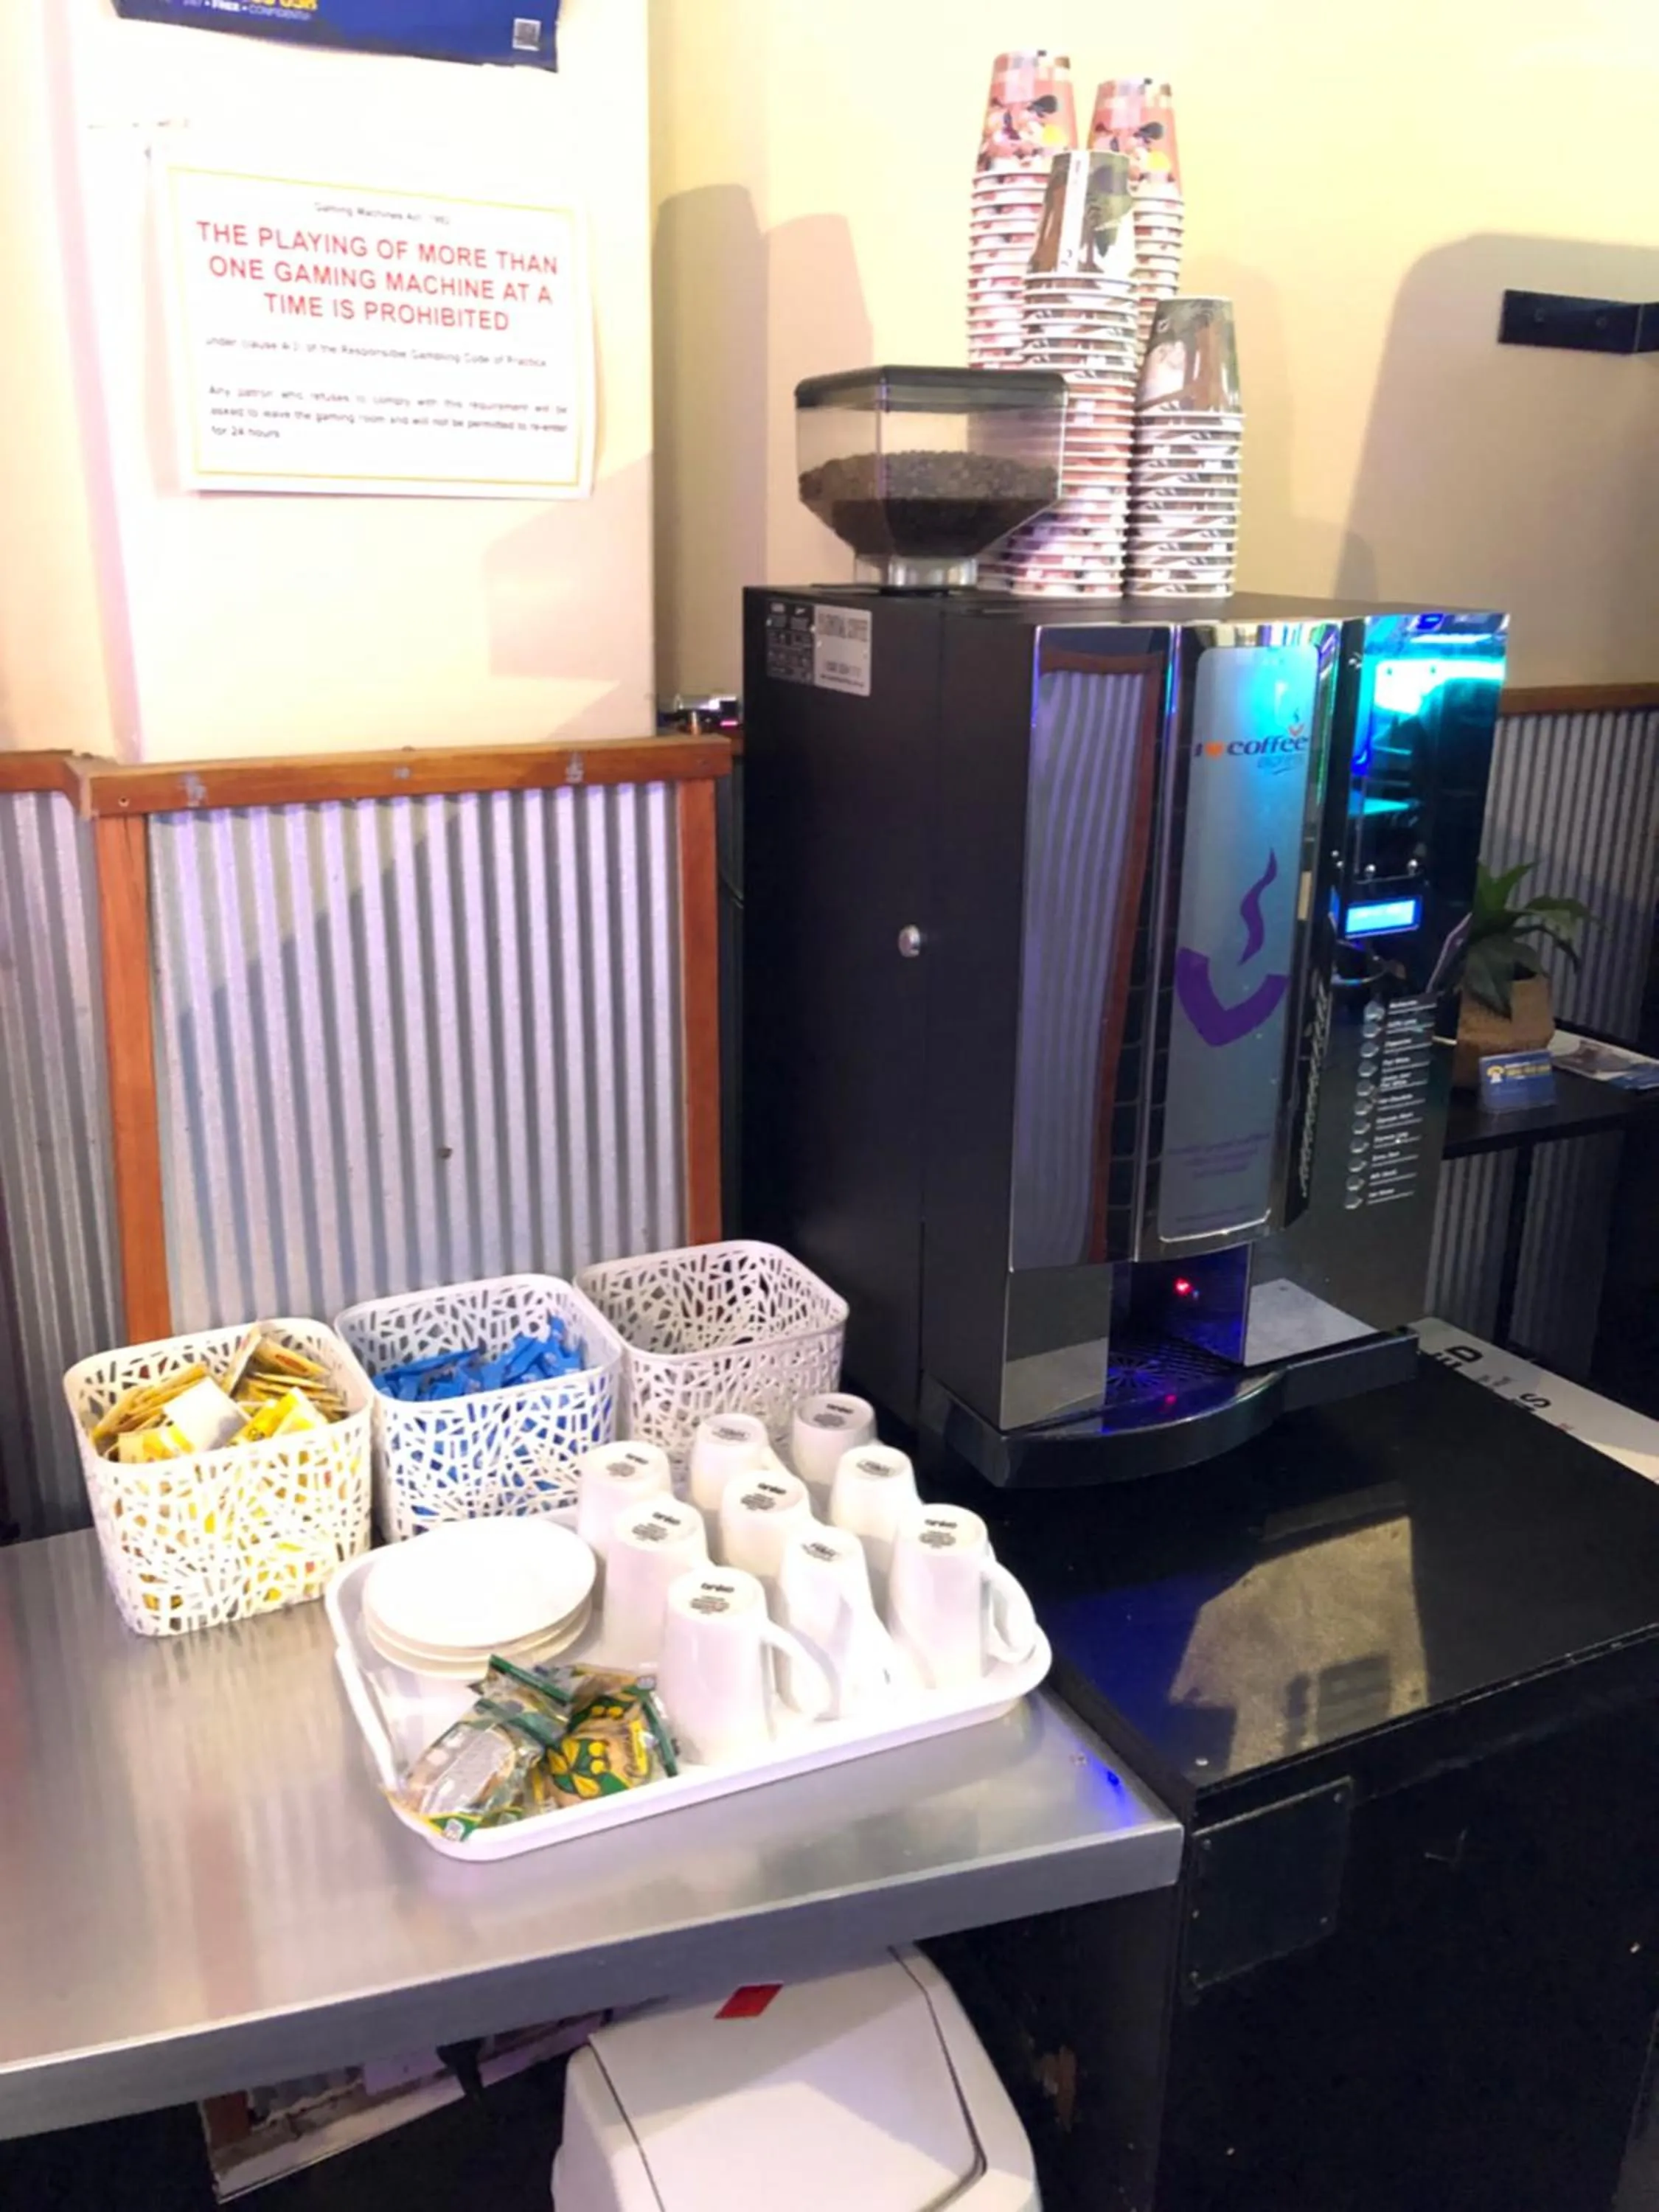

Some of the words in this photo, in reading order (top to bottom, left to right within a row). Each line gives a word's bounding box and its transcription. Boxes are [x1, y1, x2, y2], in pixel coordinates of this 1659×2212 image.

[196, 220, 248, 246] THE
[258, 226, 368, 257] PLAYING
[377, 238, 408, 260] OF
[418, 242, 487, 268] MORE
[495, 250, 557, 275] THAN
[209, 255, 265, 280] ONE
[274, 260, 377, 290] GAMING
[385, 271, 495, 299] MACHINE
[503, 282, 529, 302] AT
[538, 285, 553, 305] A
[263, 292, 324, 317] TIME
[333, 298, 355, 320] IS
[364, 301, 509, 331] PROHIBITED
[1226, 734, 1309, 756] coffee
